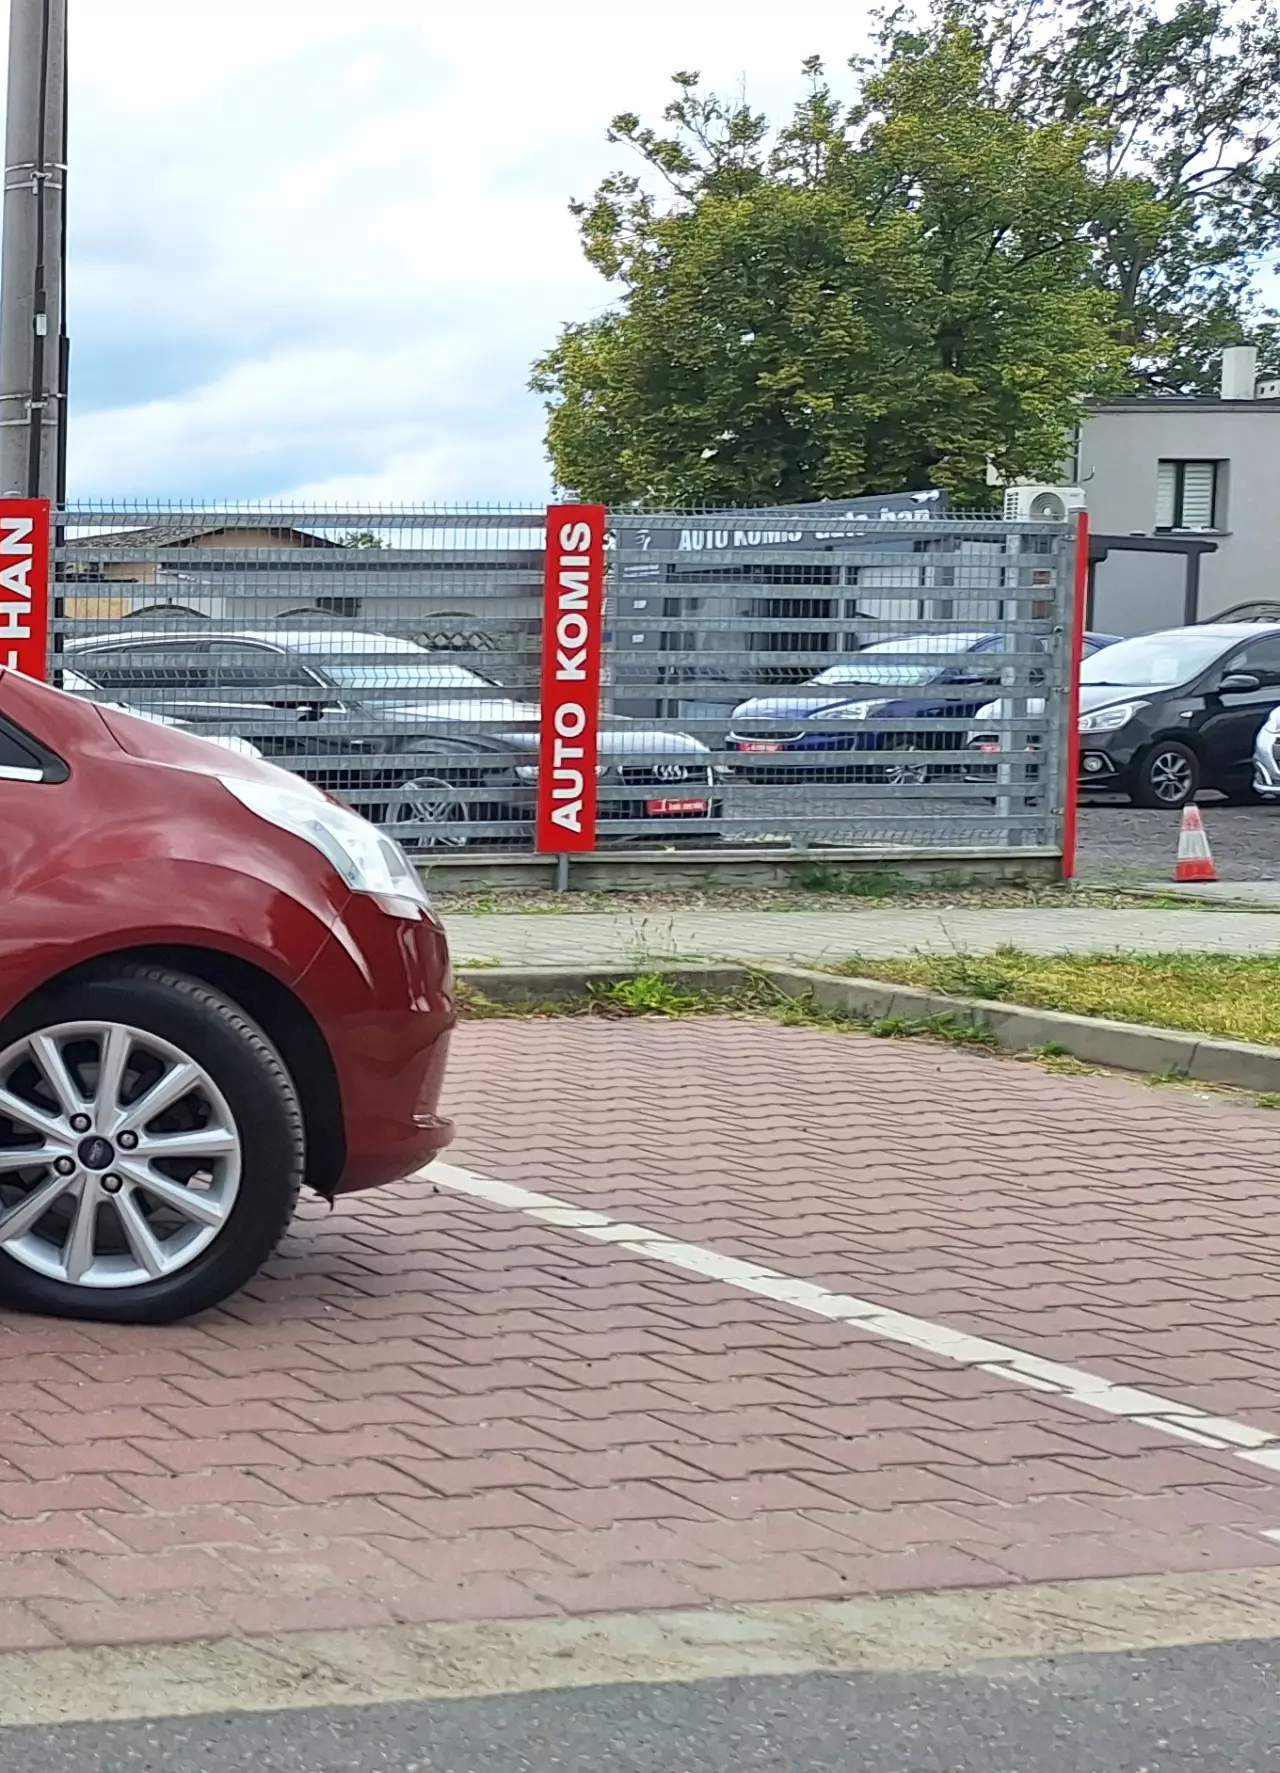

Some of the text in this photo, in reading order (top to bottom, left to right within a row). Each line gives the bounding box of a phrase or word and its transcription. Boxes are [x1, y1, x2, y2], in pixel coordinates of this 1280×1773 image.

[679, 529, 729, 551] AUTO
[551, 522, 592, 834] AUTO KOMIS
